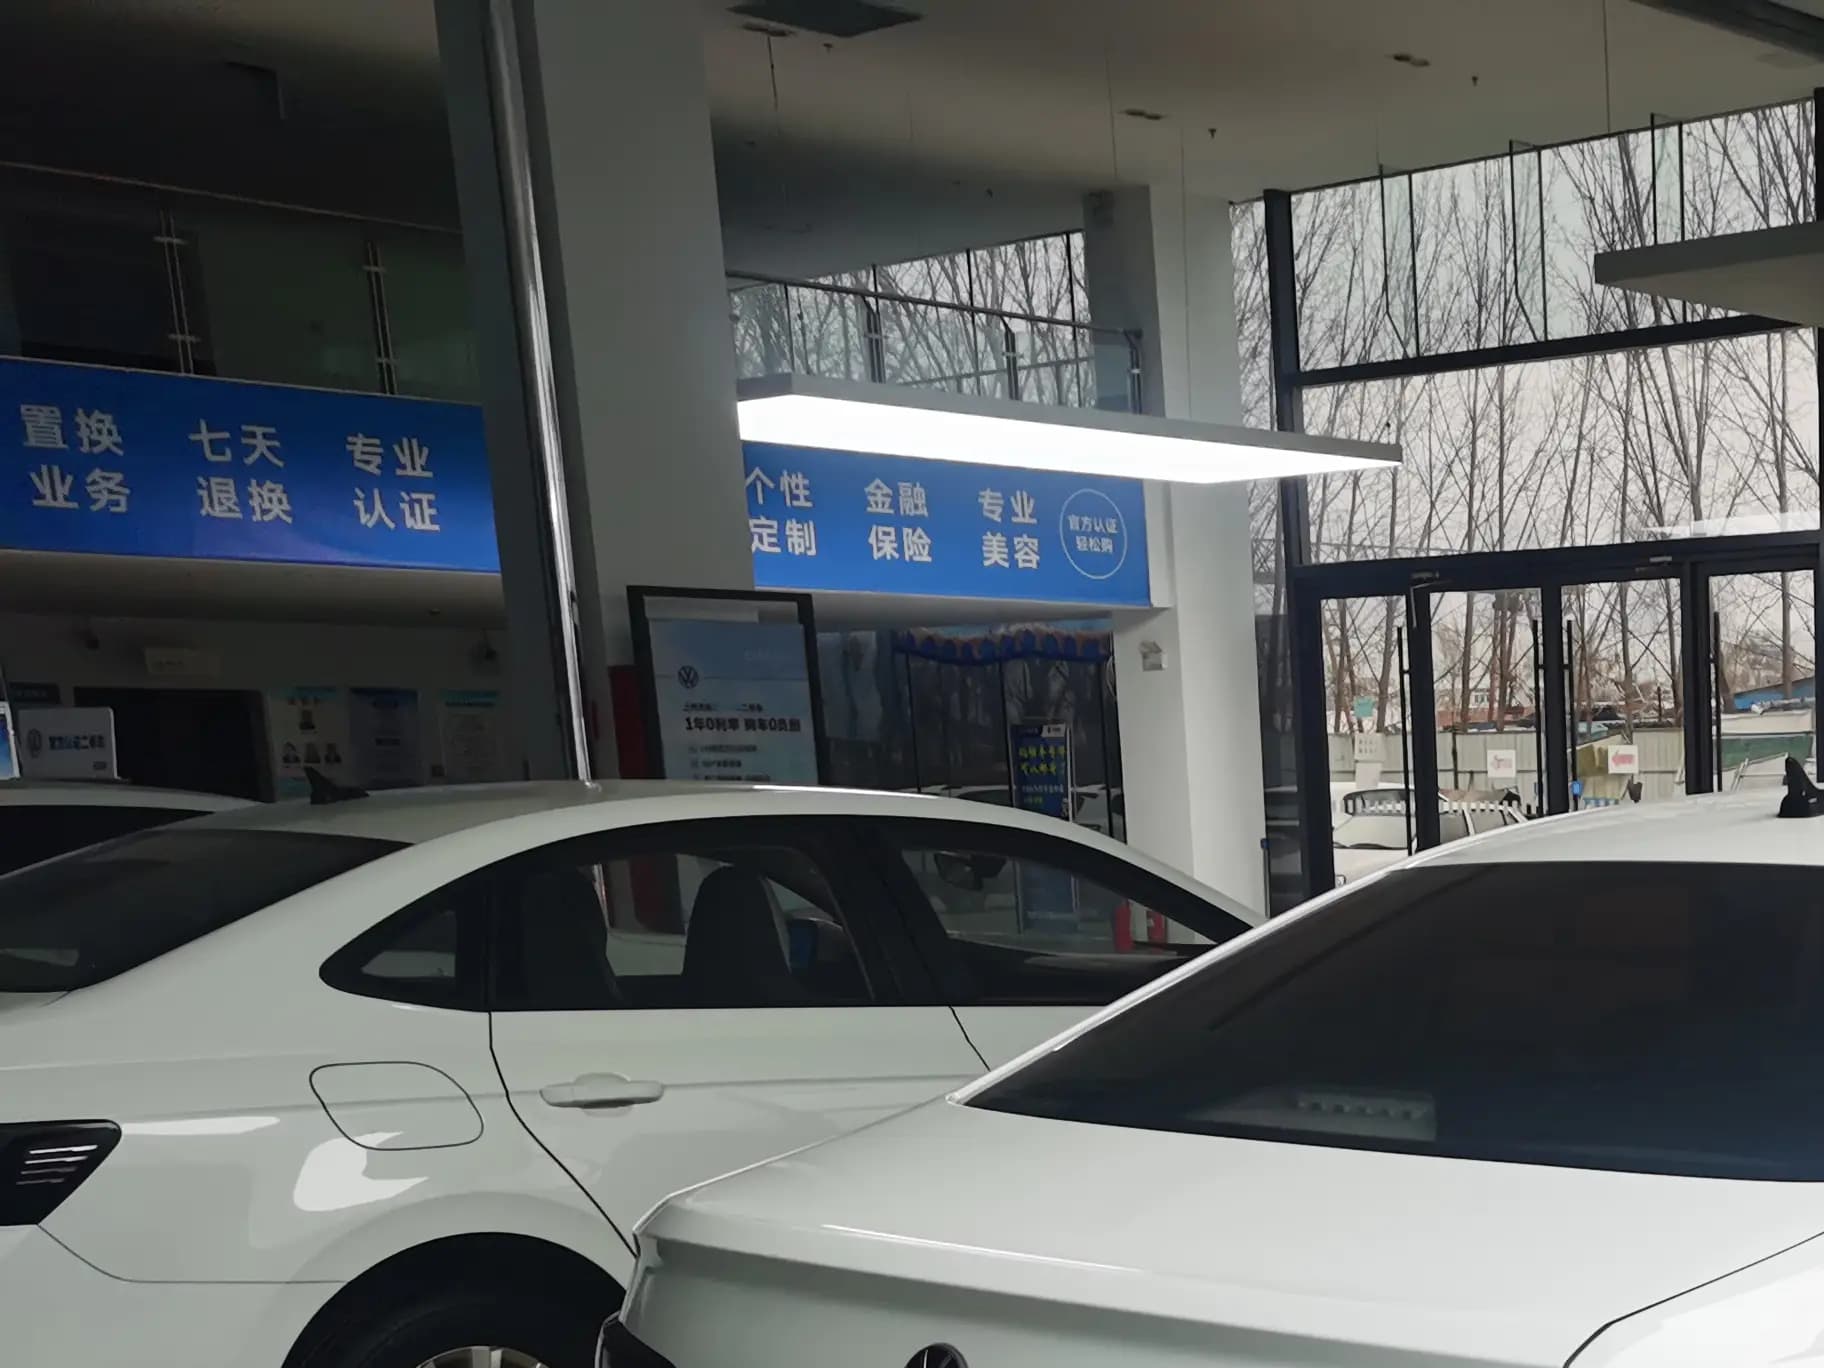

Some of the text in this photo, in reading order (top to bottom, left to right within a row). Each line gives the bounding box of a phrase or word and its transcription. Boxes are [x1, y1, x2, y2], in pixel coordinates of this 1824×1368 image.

[20, 404, 434, 480] 置换 七天 专业
[30, 464, 441, 532] 业务 退换 认证
[744, 466, 1036, 526] 个性 金融 专业
[1068, 514, 1118, 534] 官方认证
[749, 516, 1041, 570] 定制 保险 美容
[1076, 535, 1113, 555] 轻松购
